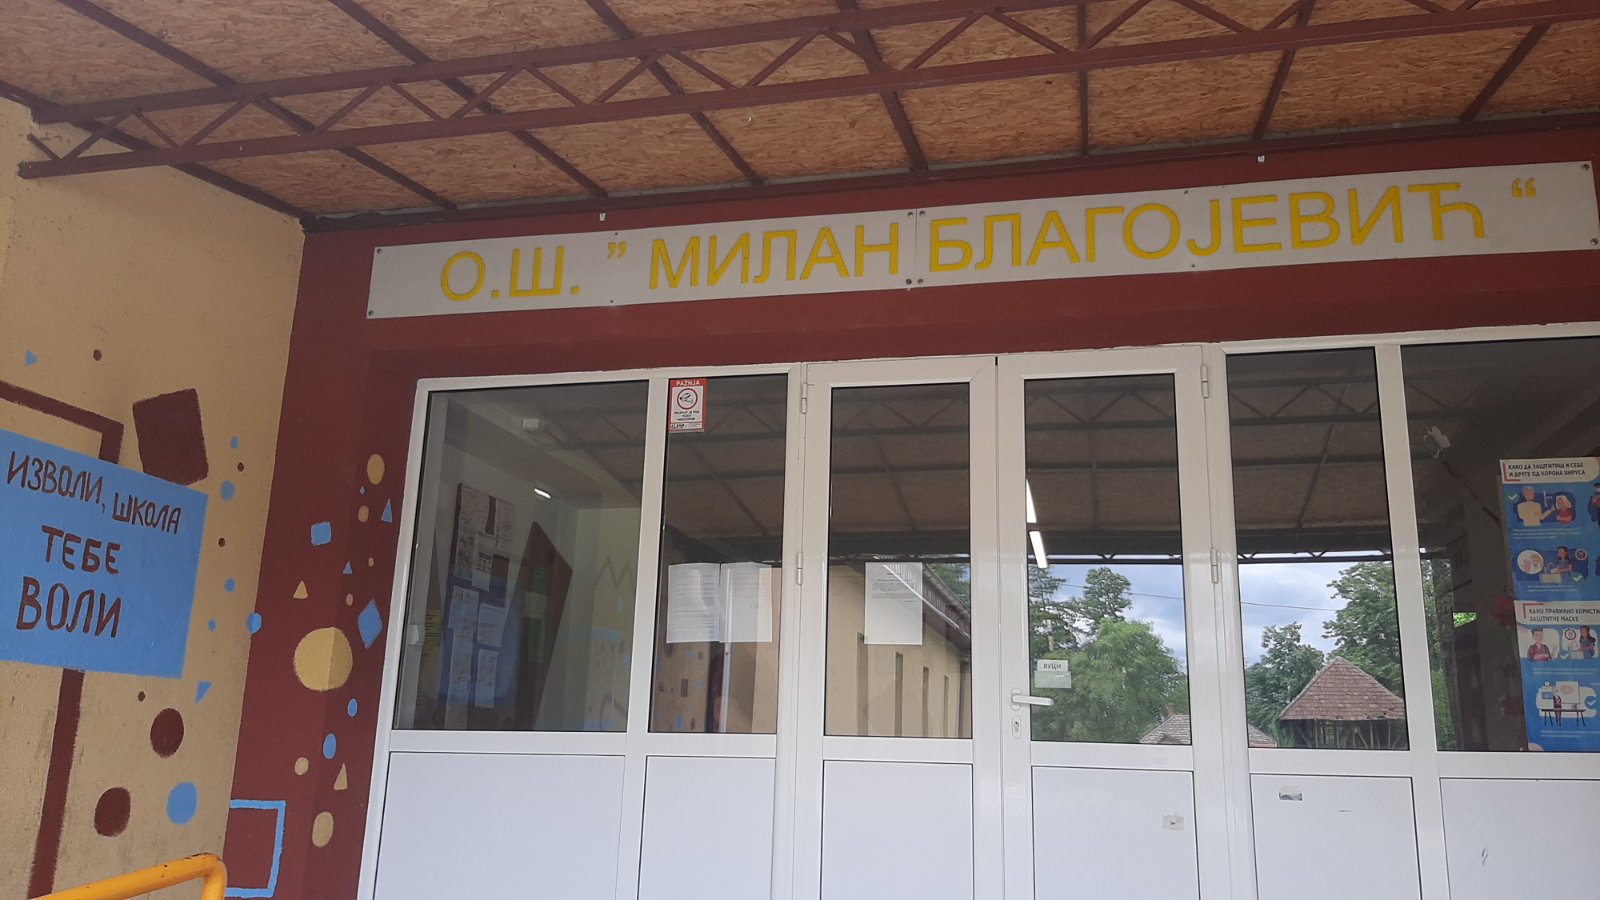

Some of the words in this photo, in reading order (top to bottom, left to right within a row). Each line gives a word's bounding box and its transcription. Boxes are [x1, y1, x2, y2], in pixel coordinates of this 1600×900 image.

[7, 451, 106, 513] ИЗВОЛИ,
[112, 492, 182, 535] ШКОЛА
[42, 525, 121, 574] ТЕБЕ
[16, 576, 121, 638] ВОЛИ
